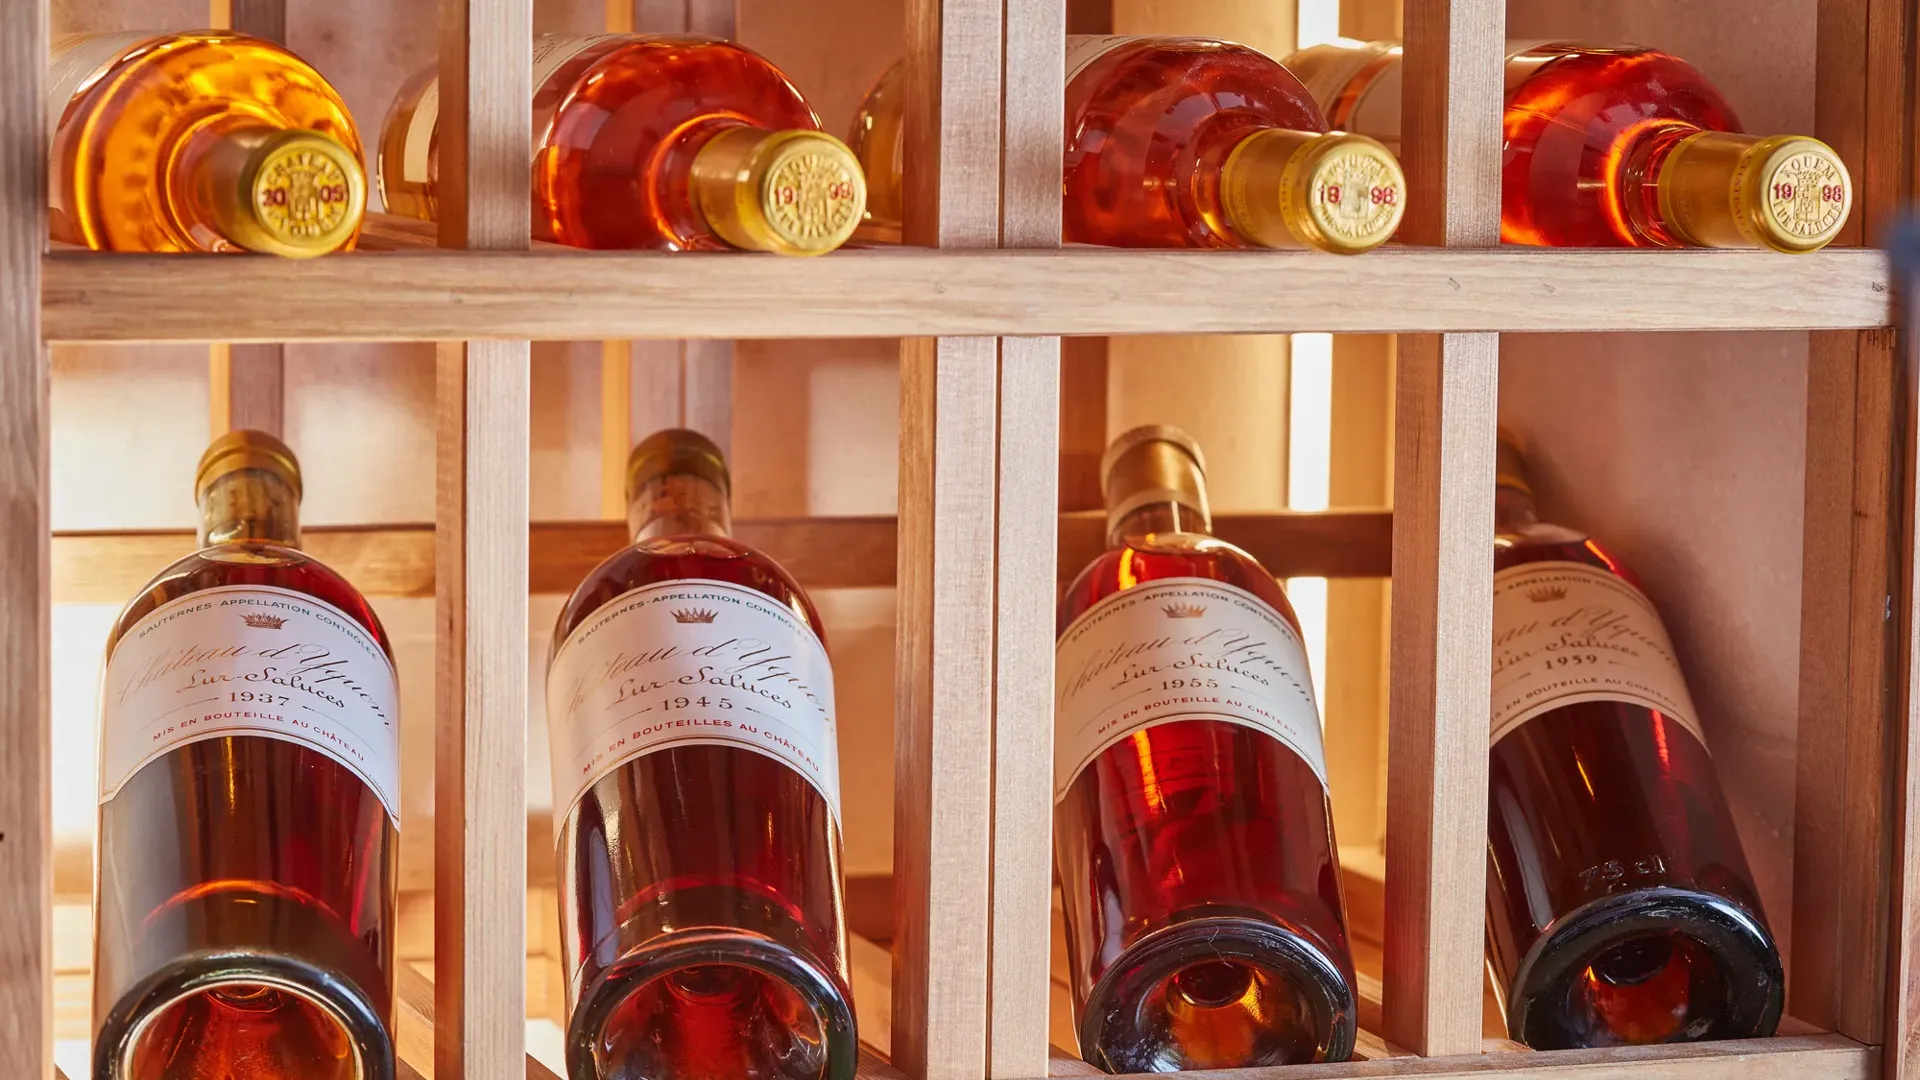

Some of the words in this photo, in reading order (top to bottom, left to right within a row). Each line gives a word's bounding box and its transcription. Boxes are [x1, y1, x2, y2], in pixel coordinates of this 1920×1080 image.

[263, 187, 287, 207] 20
[319, 184, 344, 203] 05
[1772, 182, 1793, 201] 19
[1544, 654, 1599, 671] 1959
[176, 667, 345, 708] Lur-Saluces
[606, 665, 792, 711] Lur-Saluces
[1161, 678, 1220, 690] 1955
[1506, 699, 1521, 711] EN
[1525, 677, 1599, 699] BOUTEILLE
[228, 692, 290, 707] 1937
[660, 696, 734, 712] 1945
[152, 726, 174, 742] MIS
[180, 718, 198, 728] EN
[204, 711, 285, 722] BOUTEILLE
[292, 718, 309, 729] AU
[1098, 719, 1118, 736] MIS
[1123, 709, 1138, 720] EN
[1144, 697, 1220, 711] BOUTEILLE
[1226, 699, 1243, 707] AU
[582, 752, 604, 776] MIS
[608, 739, 626, 753] EN
[632, 718, 733, 740] BOUTEILLES
[739, 722, 758, 734] AU
